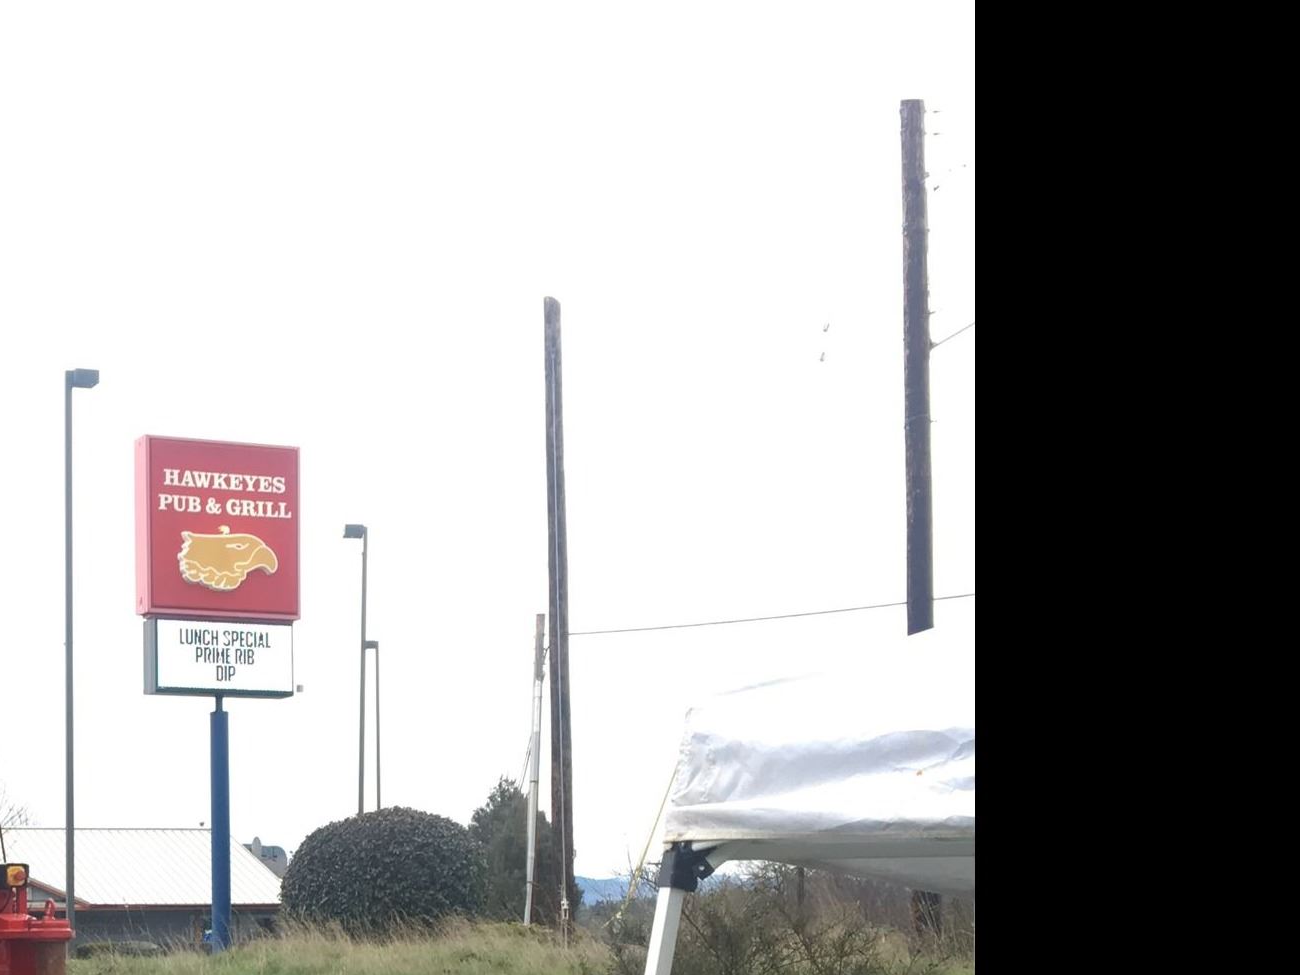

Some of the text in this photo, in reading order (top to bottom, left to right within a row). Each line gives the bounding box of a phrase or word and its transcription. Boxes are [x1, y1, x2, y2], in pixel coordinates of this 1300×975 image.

[163, 468, 286, 494] HAWKEYES
[158, 493, 292, 519] PUB & GRILL
[179, 628, 272, 648] LUNCH SPECIAL
[195, 646, 255, 665] PRIME RIB
[215, 665, 236, 682] DIP
